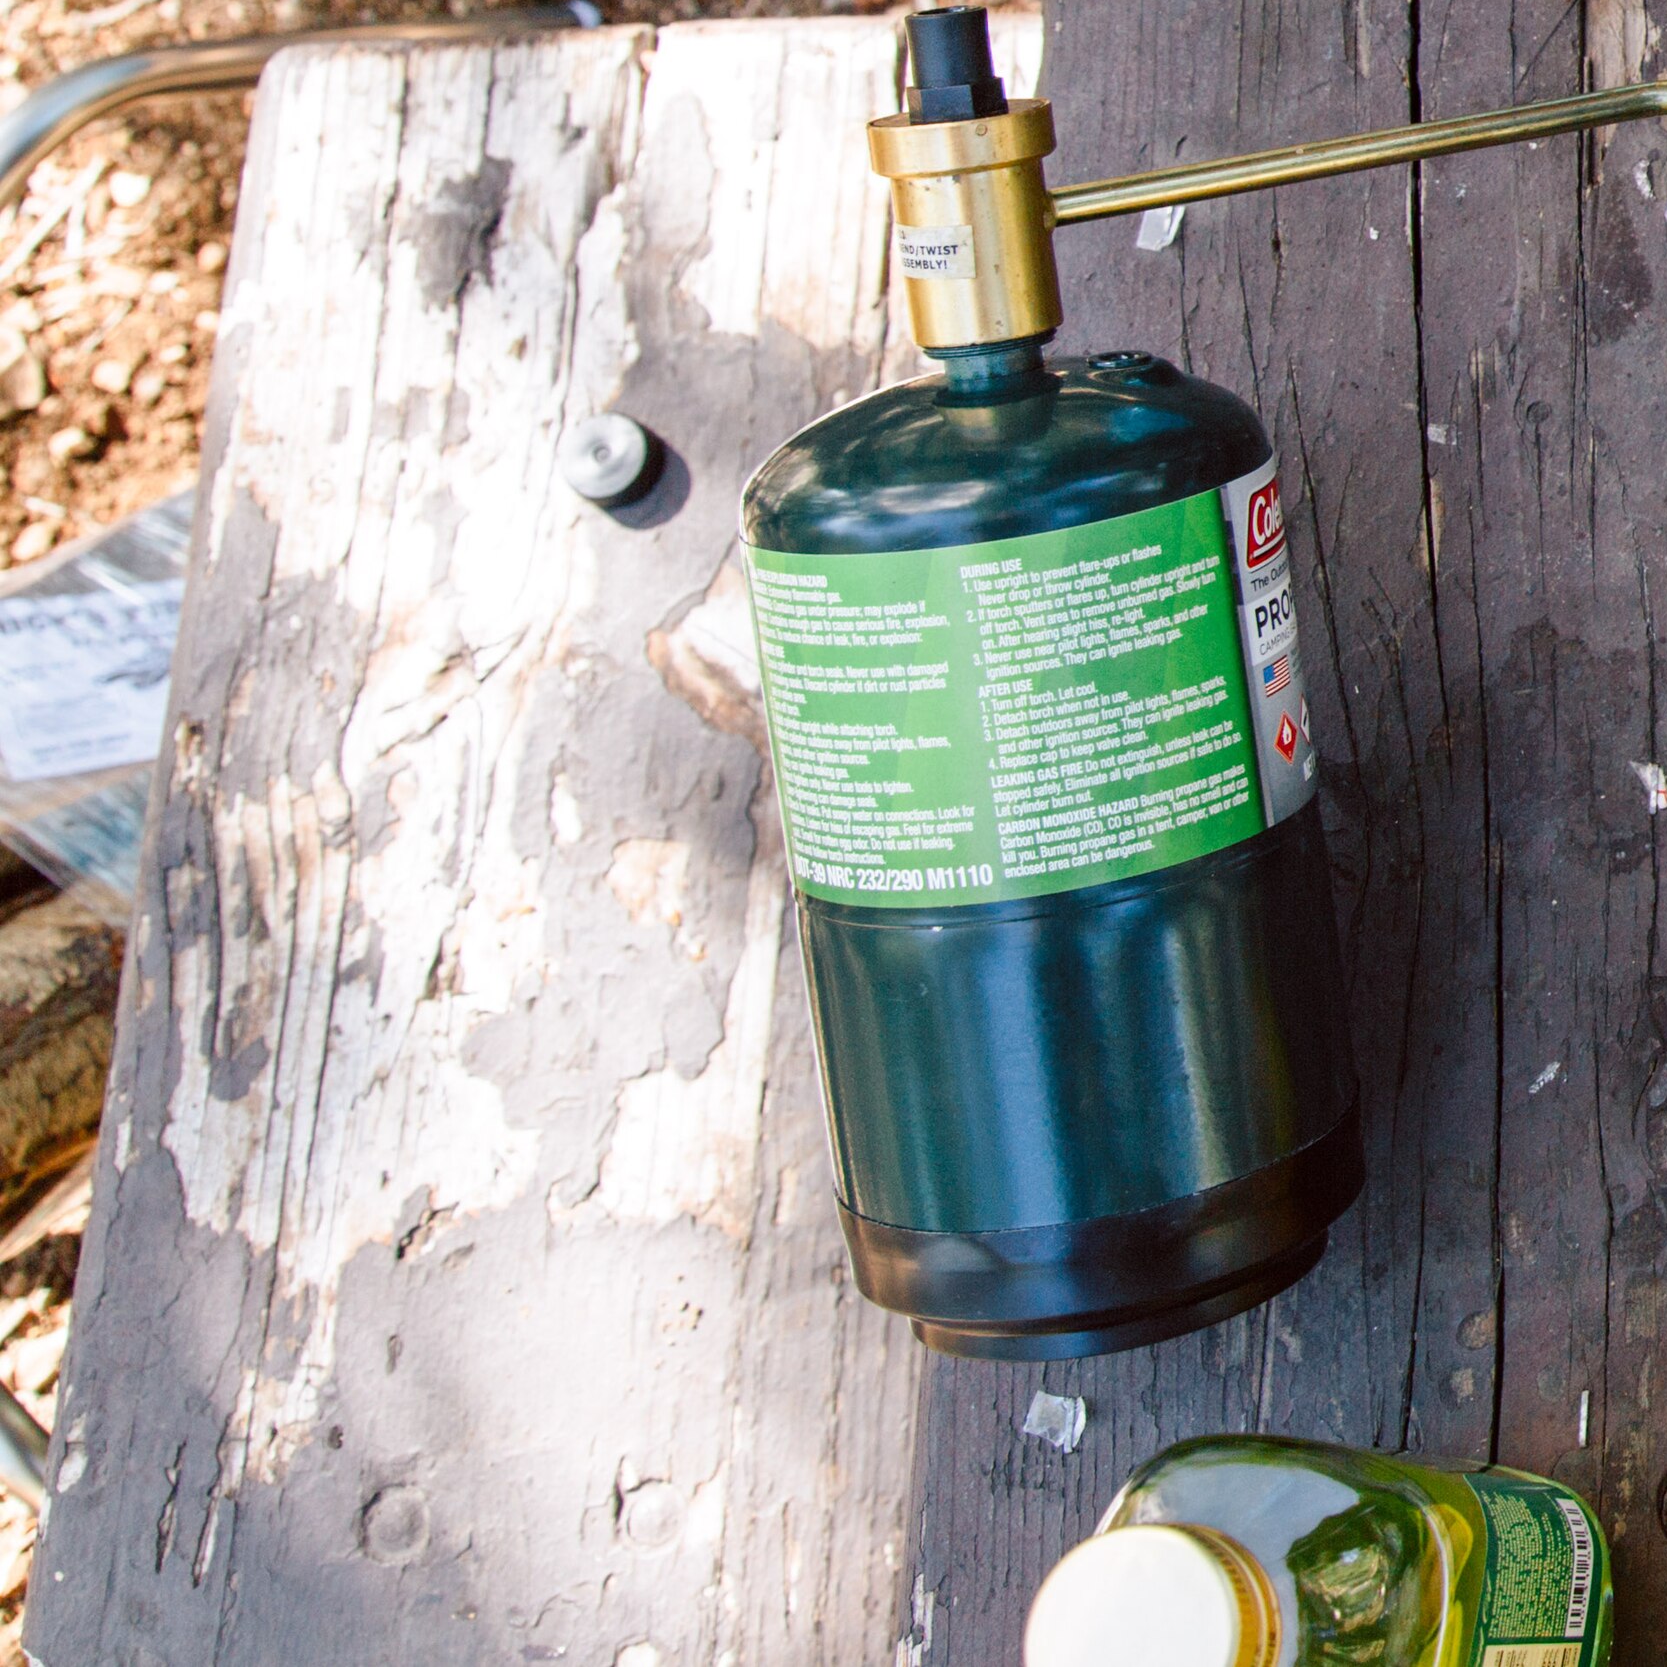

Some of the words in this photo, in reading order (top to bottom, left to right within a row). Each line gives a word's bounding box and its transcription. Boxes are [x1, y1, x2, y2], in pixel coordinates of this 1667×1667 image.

[960, 562, 999, 578] DURING
[1001, 558, 1022, 572] USE
[962, 581, 973, 592] 1.
[973, 580, 992, 591] Use
[994, 572, 1028, 589] upright
[1029, 571, 1040, 582] to
[1042, 563, 1077, 582] prevent
[1078, 555, 1120, 573] flare-ups
[1250, 576, 1270, 592] The
[918, 600, 926, 611] if
[966, 610, 977, 622] 2.
[977, 608, 985, 620] If
[986, 605, 1012, 619] torch
[1013, 599, 1053, 616] sputters
[1054, 597, 1064, 607] or
[1066, 591, 1093, 605] flares
[1094, 589, 1110, 600] up,
[1110, 583, 1129, 595] turn
[978, 592, 1005, 605] Never
[1008, 589, 1030, 601] drop
[1032, 586, 1042, 597] or
[1044, 581, 1072, 594] throw
[1074, 572, 1111, 590] cylinder.
[904, 614, 950, 629] explosion,
[979, 622, 992, 635] off
[994, 618, 1023, 632] torch.
[1022, 614, 1045, 628] Vent
[1047, 611, 1068, 624] area
[1069, 609, 1080, 619] to
[1081, 601, 1115, 616] remove
[1117, 588, 1157, 609] unburned
[982, 639, 998, 649] on.
[998, 634, 1021, 647] After
[1023, 628, 1059, 643] hearing
[1061, 620, 1087, 636] slight
[1088, 618, 1111, 630] hiss,
[1111, 607, 1146, 625] re-light.
[972, 653, 983, 665] 3.
[984, 651, 1012, 663] Never
[1014, 648, 1032, 659] use
[1033, 643, 1055, 656] near
[1057, 636, 1078, 653] pilot
[1080, 632, 1109, 648] lights,
[1108, 625, 1143, 640] flames,
[986, 664, 1021, 680] ignition
[1022, 658, 1063, 672] sources.
[1063, 652, 1086, 664] They
[1089, 648, 1106, 660] can
[1107, 640, 1132, 657] ignite
[979, 682, 1010, 697] AFTER
[1012, 678, 1032, 692] USE
[980, 701, 990, 712] 1.
[991, 699, 1012, 710] Turn
[1014, 694, 1027, 707] off
[1028, 690, 1057, 705] torch.
[1058, 686, 1074, 700] Let
[1075, 681, 1098, 696] cool.
[982, 715, 992, 727] 2.
[994, 710, 1027, 725] Detach
[1028, 705, 1053, 719] torch
[1055, 701, 1081, 714] when
[1083, 695, 1099, 708] not
[1100, 694, 1110, 705] in
[1111, 691, 1131, 703] use.
[984, 729, 995, 741] 3.
[995, 724, 1029, 739] Detach
[1031, 718, 1072, 734] outdoors
[1074, 712, 1099, 726] away
[1100, 707, 1122, 720] from
[1124, 699, 1144, 717] pilot
[988, 758, 999, 769] 4.
[1000, 753, 1037, 768] Replace
[1039, 751, 1057, 762] cap
[1059, 747, 1069, 758] to
[1071, 743, 1094, 755] keep
[1096, 737, 1120, 750] valve
[1121, 730, 1149, 745] clean.
[998, 740, 1016, 754] and
[1018, 738, 1042, 751] other
[1044, 731, 1080, 748] ignition
[1081, 723, 1121, 739] sources.
[1120, 716, 1143, 729] They
[1144, 712, 1161, 724] can
[991, 771, 1035, 787] LEAKING
[1036, 767, 1058, 781] GAS
[1060, 762, 1083, 776] FIRE
[1084, 760, 1098, 772] Do
[1100, 755, 1115, 768] not
[1117, 743, 1165, 764] extinguish,
[993, 786, 1031, 802] stopped
[1032, 781, 1063, 796] safely.
[1064, 772, 1107, 790] Eliminate
[1109, 768, 1120, 781] all
[1122, 761, 1155, 779] ignition
[937, 806, 960, 819] Look
[961, 805, 974, 816] for
[995, 804, 1011, 817] Let
[1013, 799, 1049, 815] cylinder
[1051, 795, 1073, 808] burn
[1075, 790, 1094, 803] out.
[998, 817, 1040, 834] CARBON
[1042, 807, 1096, 827] MONOXIDE
[1098, 797, 1138, 816] HAZARD
[1139, 789, 1174, 806] Burning
[936, 821, 972, 833] extreme
[1000, 835, 1034, 848] Carbon
[1035, 826, 1081, 843] Monoxide
[1083, 820, 1106, 835] (CO).
[1107, 816, 1121, 829] CO
[1123, 814, 1132, 825] is
[1133, 805, 1172, 823] invisible,
[1001, 850, 1016, 863] kill
[1018, 850, 1040, 863] you.
[1039, 842, 1077, 858] Burning
[1079, 834, 1117, 852] propane
[1118, 829, 1135, 844] gas
[1136, 826, 1146, 837] in
[1147, 825, 1154, 834] a
[1155, 817, 1176, 831] tent,
[826, 864, 854, 888] NRC
[856, 868, 922, 890] 232/290
[926, 864, 992, 889] M1110
[1005, 860, 1046, 877] enclosed
[1048, 859, 1069, 871] area
[1071, 855, 1088, 866] can
[1090, 851, 1102, 862] be
[1104, 839, 1155, 859] dangerous.
